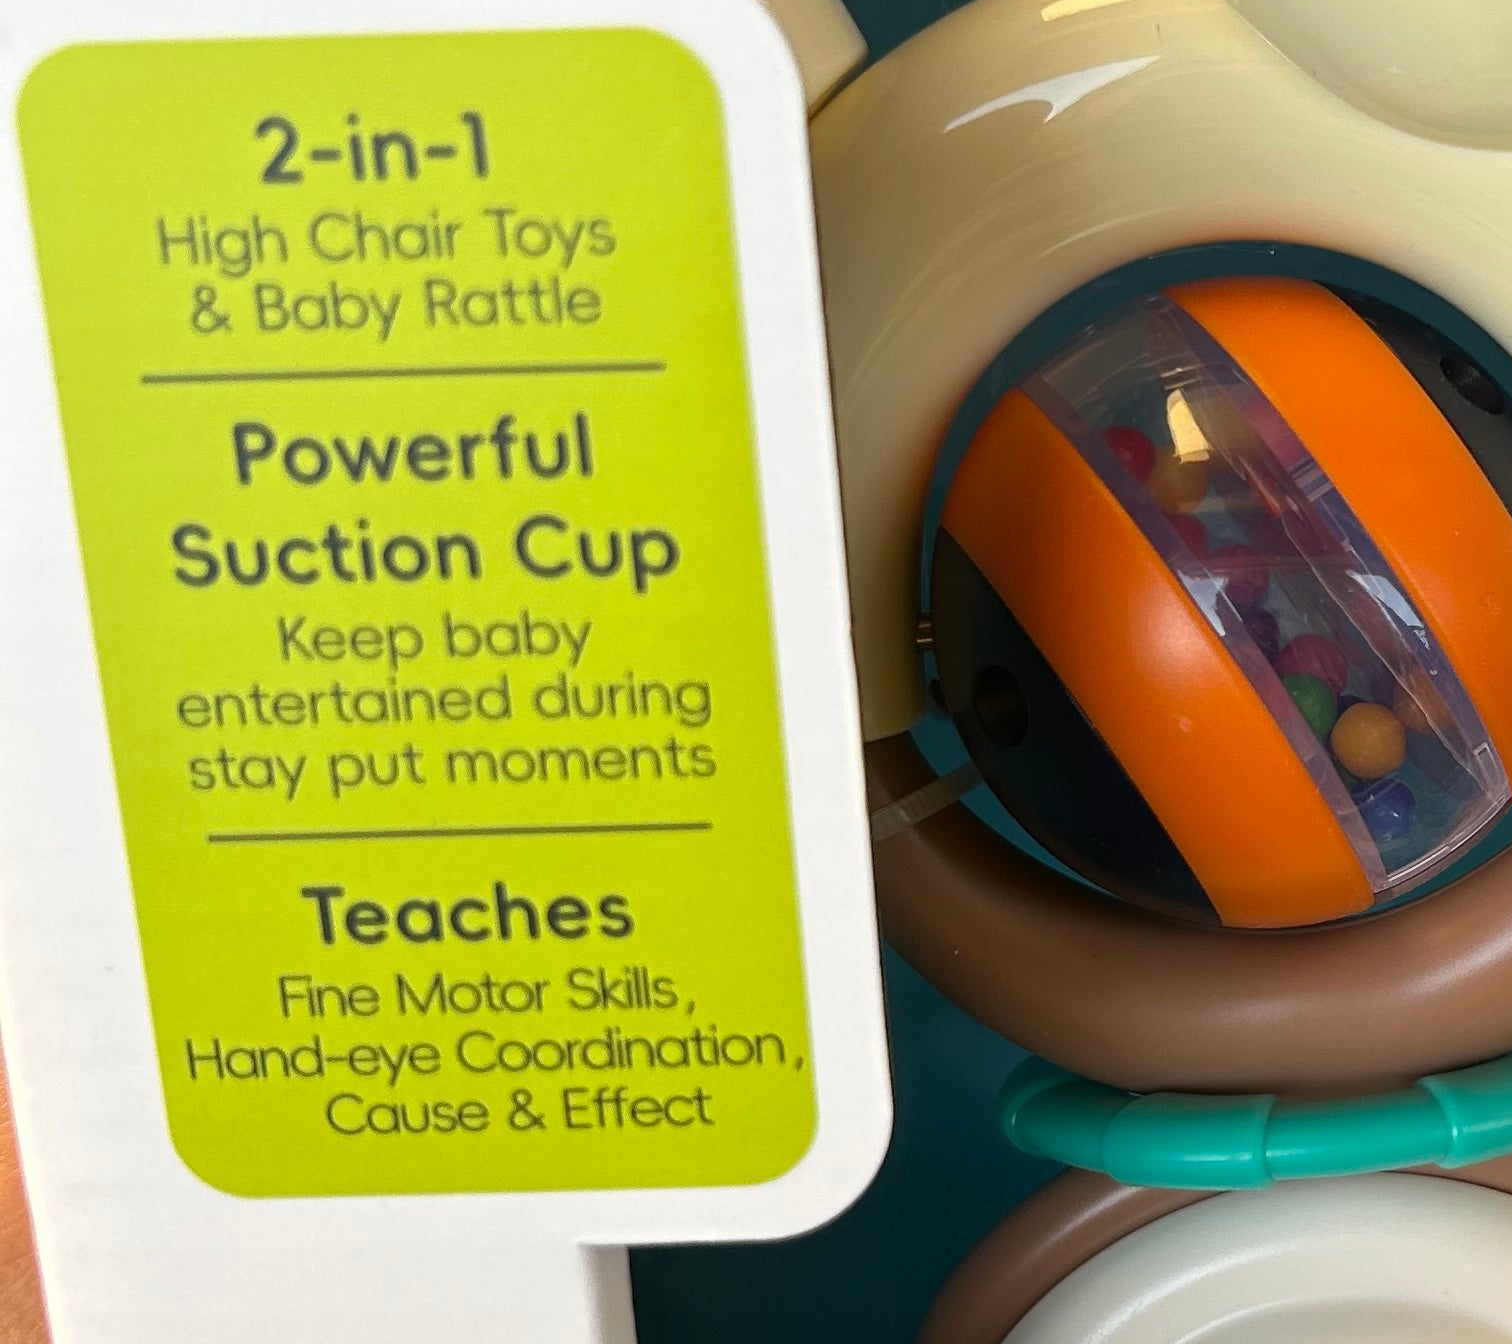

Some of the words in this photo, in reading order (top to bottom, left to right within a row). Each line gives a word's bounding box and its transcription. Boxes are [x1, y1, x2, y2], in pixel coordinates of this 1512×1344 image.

[252, 111, 492, 186] 2-in-1
[156, 213, 290, 278] High
[308, 209, 463, 265] Chair
[486, 205, 620, 271] Toys
[190, 285, 232, 333] &
[256, 281, 400, 342] Baby
[425, 275, 604, 327] Rattle
[231, 412, 596, 488] Powerful
[171, 520, 485, 589] Suction
[515, 512, 683, 593] Cup
[277, 615, 426, 671] Keep
[443, 610, 593, 668] baby
[177, 674, 513, 730] entertained
[531, 671, 714, 730] during
[189, 749, 307, 798] stay
[328, 745, 428, 802] put
[446, 736, 719, 787] moments
[301, 881, 637, 948] Teaches
[278, 974, 382, 1020] Fine
[396, 970, 550, 1017] Motor
[566, 965, 699, 1018] Skills,
[184, 1038, 443, 1090] Hand-eye
[456, 1026, 806, 1074] Coordination,
[325, 1092, 492, 1138] Cause
[507, 1088, 547, 1132] &
[564, 1086, 715, 1133] Effect
